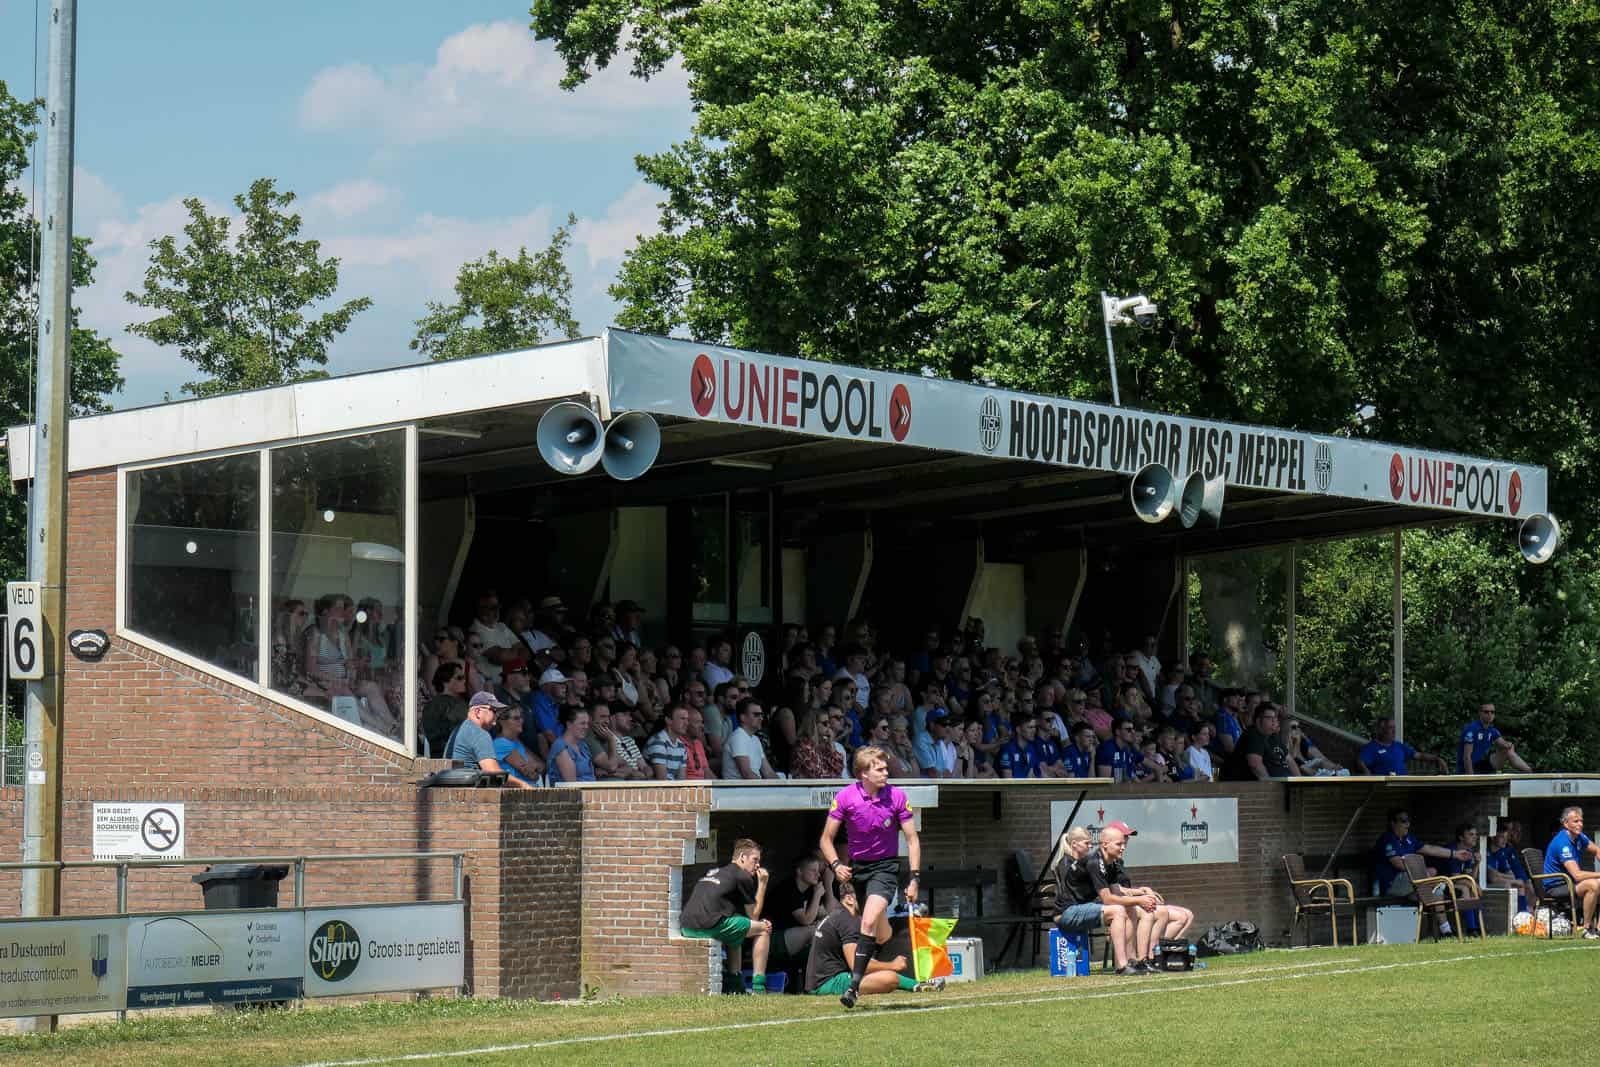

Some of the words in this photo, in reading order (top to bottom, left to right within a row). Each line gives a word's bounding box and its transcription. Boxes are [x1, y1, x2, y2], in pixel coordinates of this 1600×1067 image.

[723, 358, 882, 438] UNIEPOOL
[1009, 399, 1182, 479] HOOFDSPONSOR
[1187, 426, 1233, 481] MSC
[1236, 432, 1306, 490] MEPPEL
[1408, 456, 1504, 513] UNIEPOOL
[12, 588, 34, 605] VELD
[14, 617, 36, 673] 6
[11, 939, 66, 958] Dustcontrol
[311, 935, 360, 968] Sligro
[368, 940, 402, 959] Groots
[405, 938, 415, 956] in
[417, 936, 461, 961] genieten
